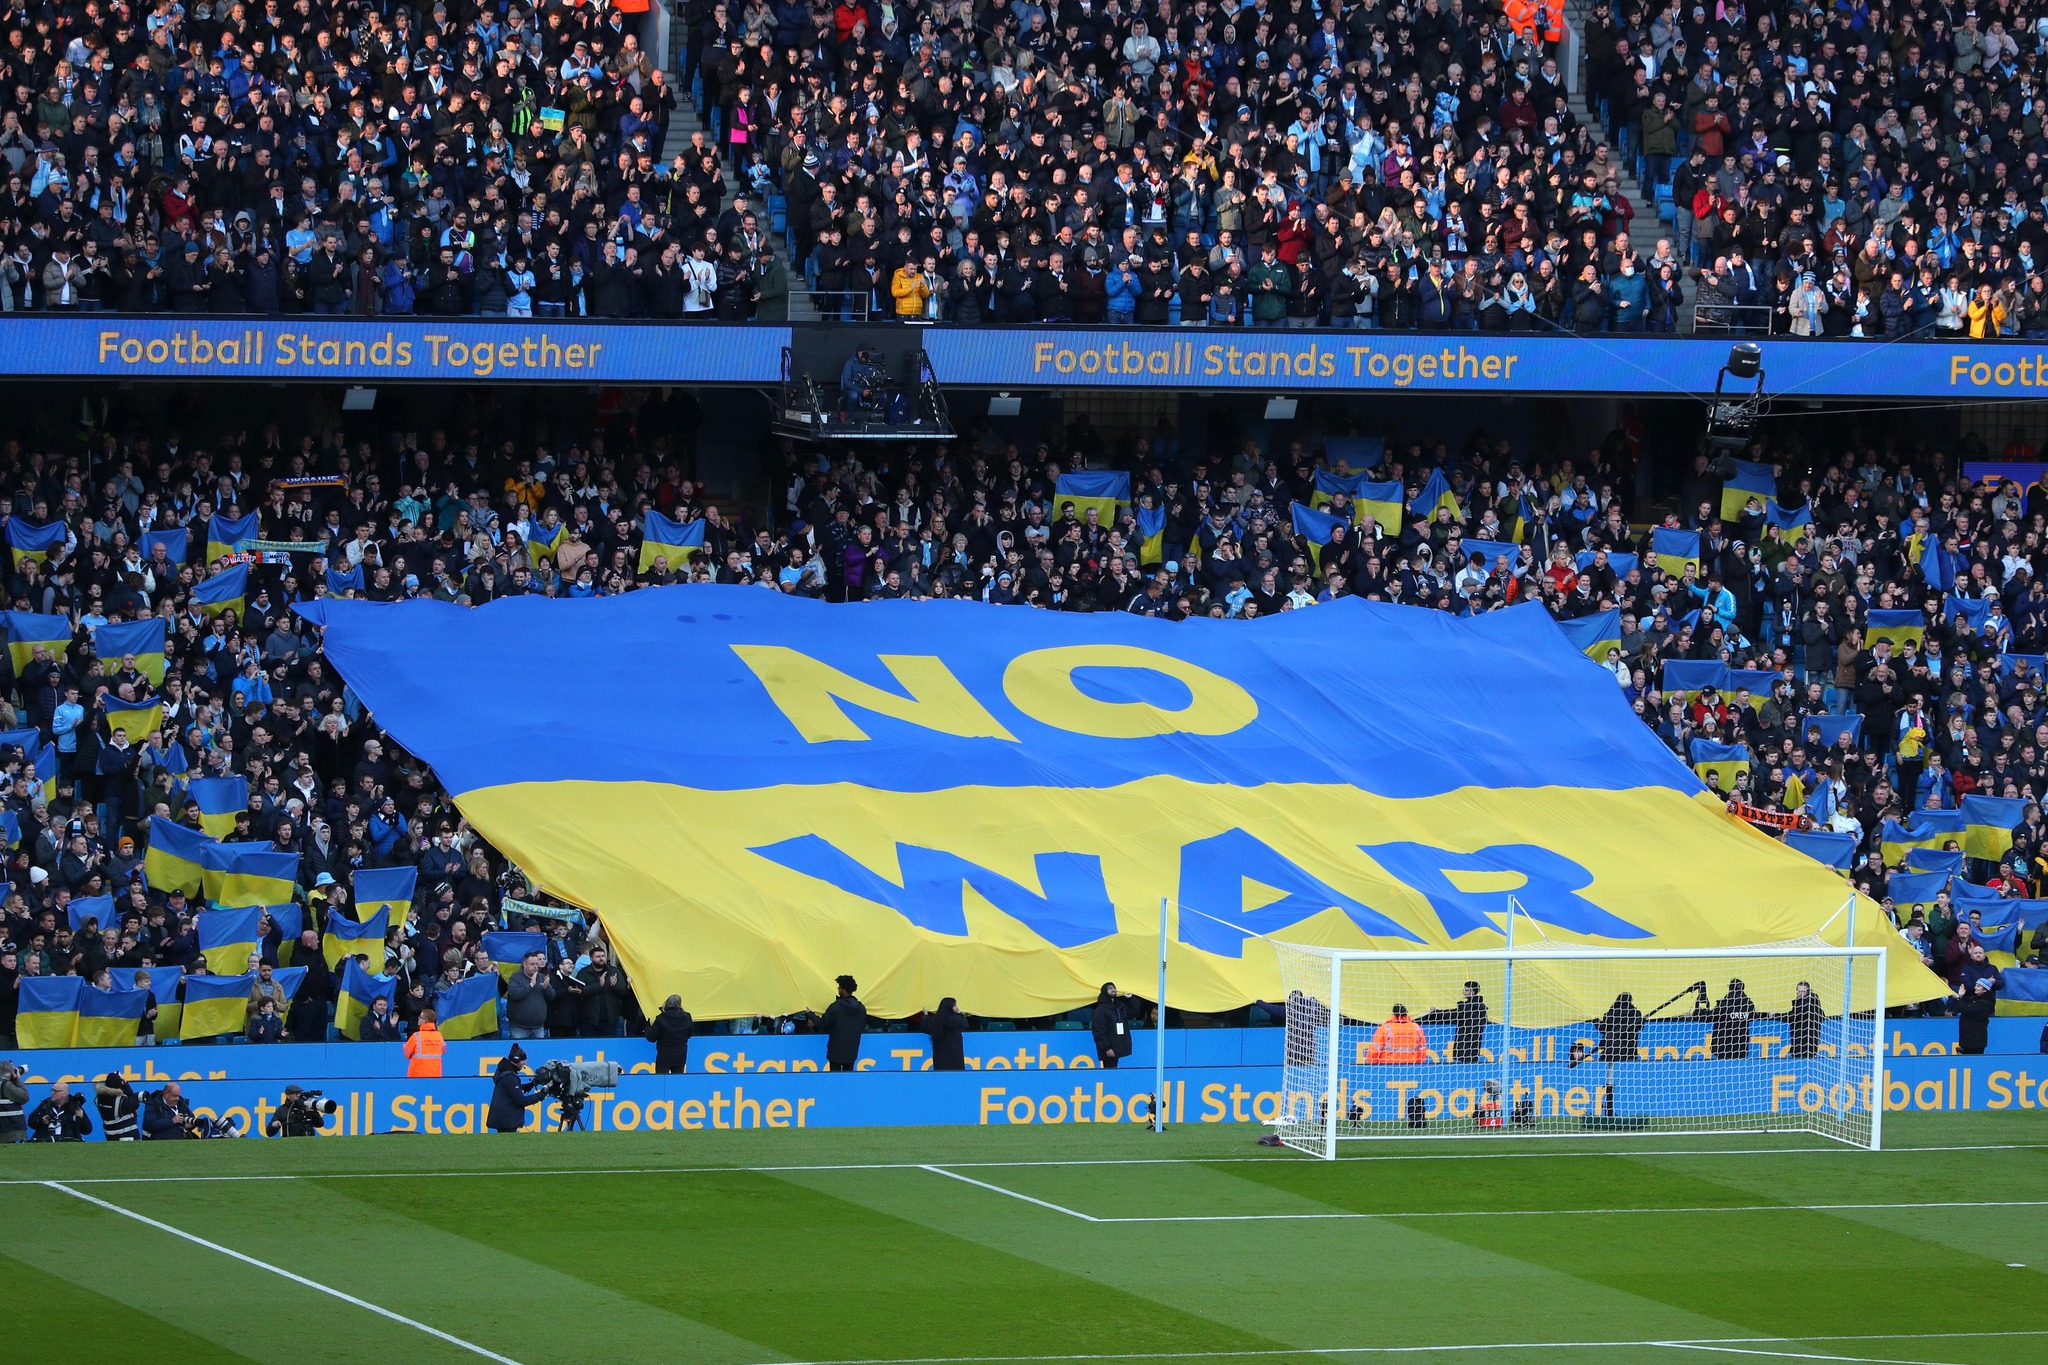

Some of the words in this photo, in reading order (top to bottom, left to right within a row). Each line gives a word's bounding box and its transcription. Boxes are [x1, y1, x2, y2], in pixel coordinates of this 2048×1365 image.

[98, 329, 263, 364] Football
[275, 331, 413, 367] Stands
[423, 333, 602, 376] Together
[1034, 341, 1193, 375] Football
[1203, 343, 1336, 376] Stands
[1346, 345, 1518, 387] Together
[729, 643, 1259, 743] NO
[508, 901, 565, 918] UKRAINE
[744, 827, 1657, 958] WAR
[1729, 1012, 1750, 1020] CREW
[704, 1052, 876, 1073] Stans
[979, 1081, 1185, 1125] Football
[1771, 1068, 1971, 1112] Football
